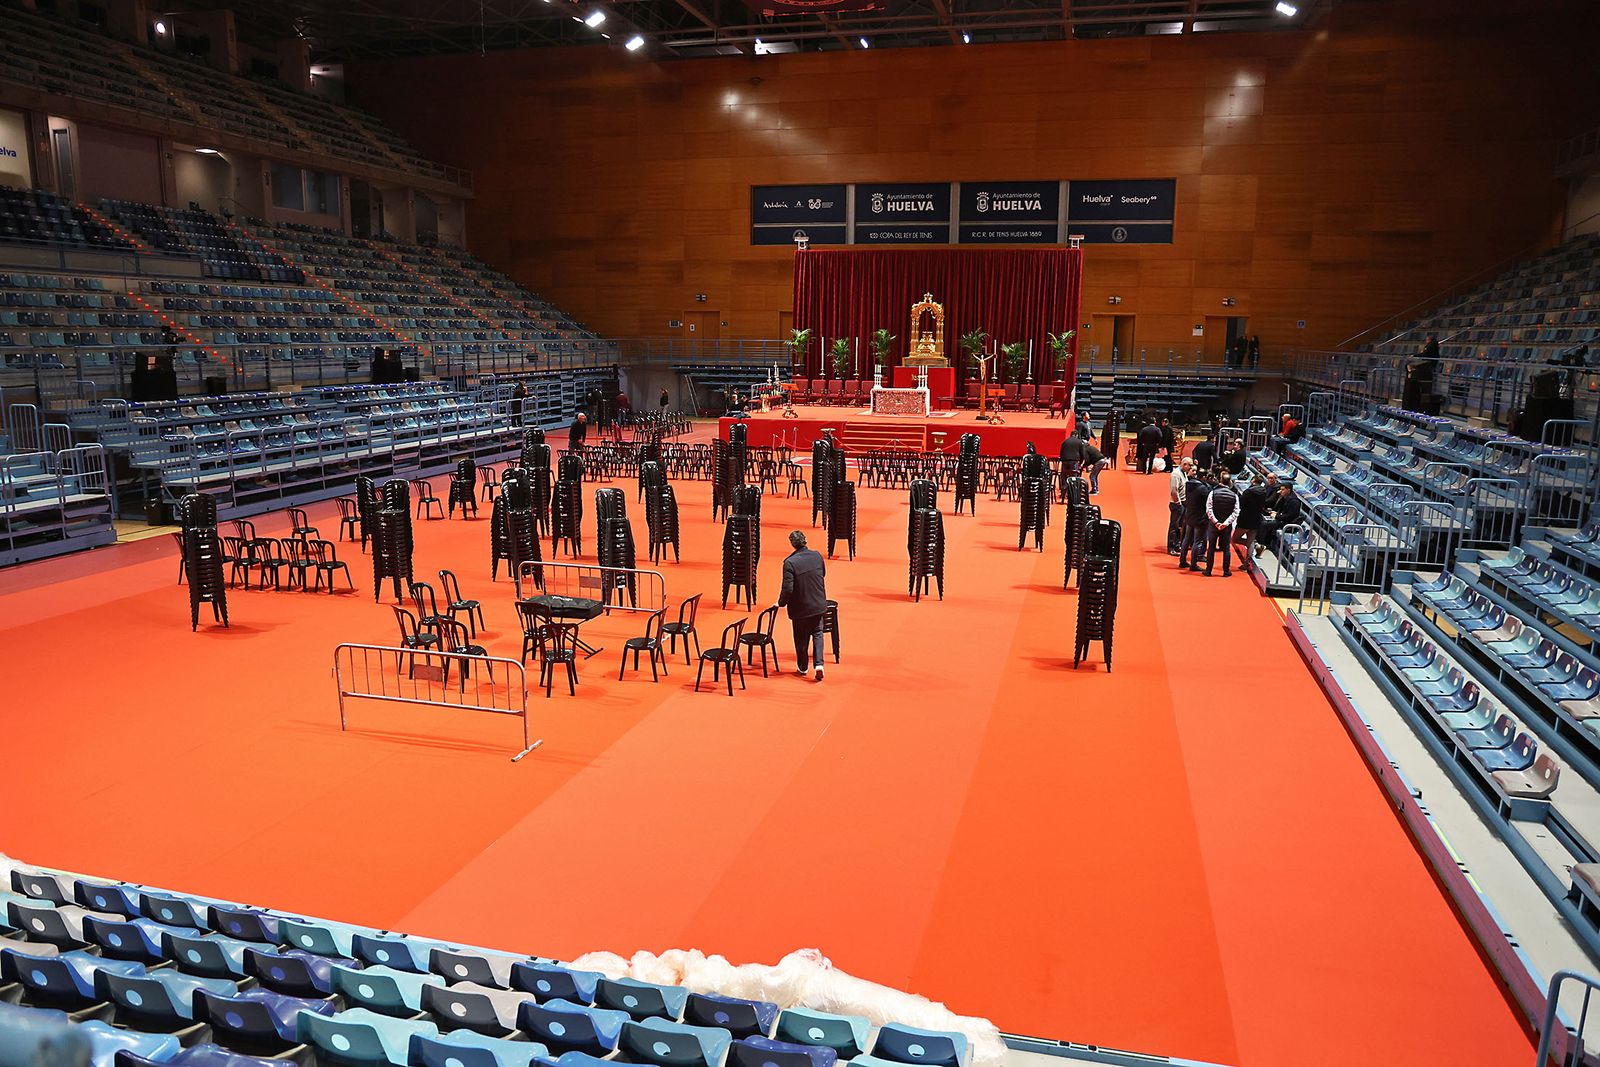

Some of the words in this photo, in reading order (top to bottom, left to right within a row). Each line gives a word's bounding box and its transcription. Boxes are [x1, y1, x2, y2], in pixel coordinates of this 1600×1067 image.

[1082, 194, 1111, 203] Huelva
[1121, 195, 1151, 204] Seabery
[887, 201, 934, 211] HUELVA
[993, 200, 1042, 211] HUELVA
[880, 231, 894, 239] COPA
[894, 231, 903, 239] DEL
[903, 231, 912, 239] REY
[912, 231, 919, 239] DE
